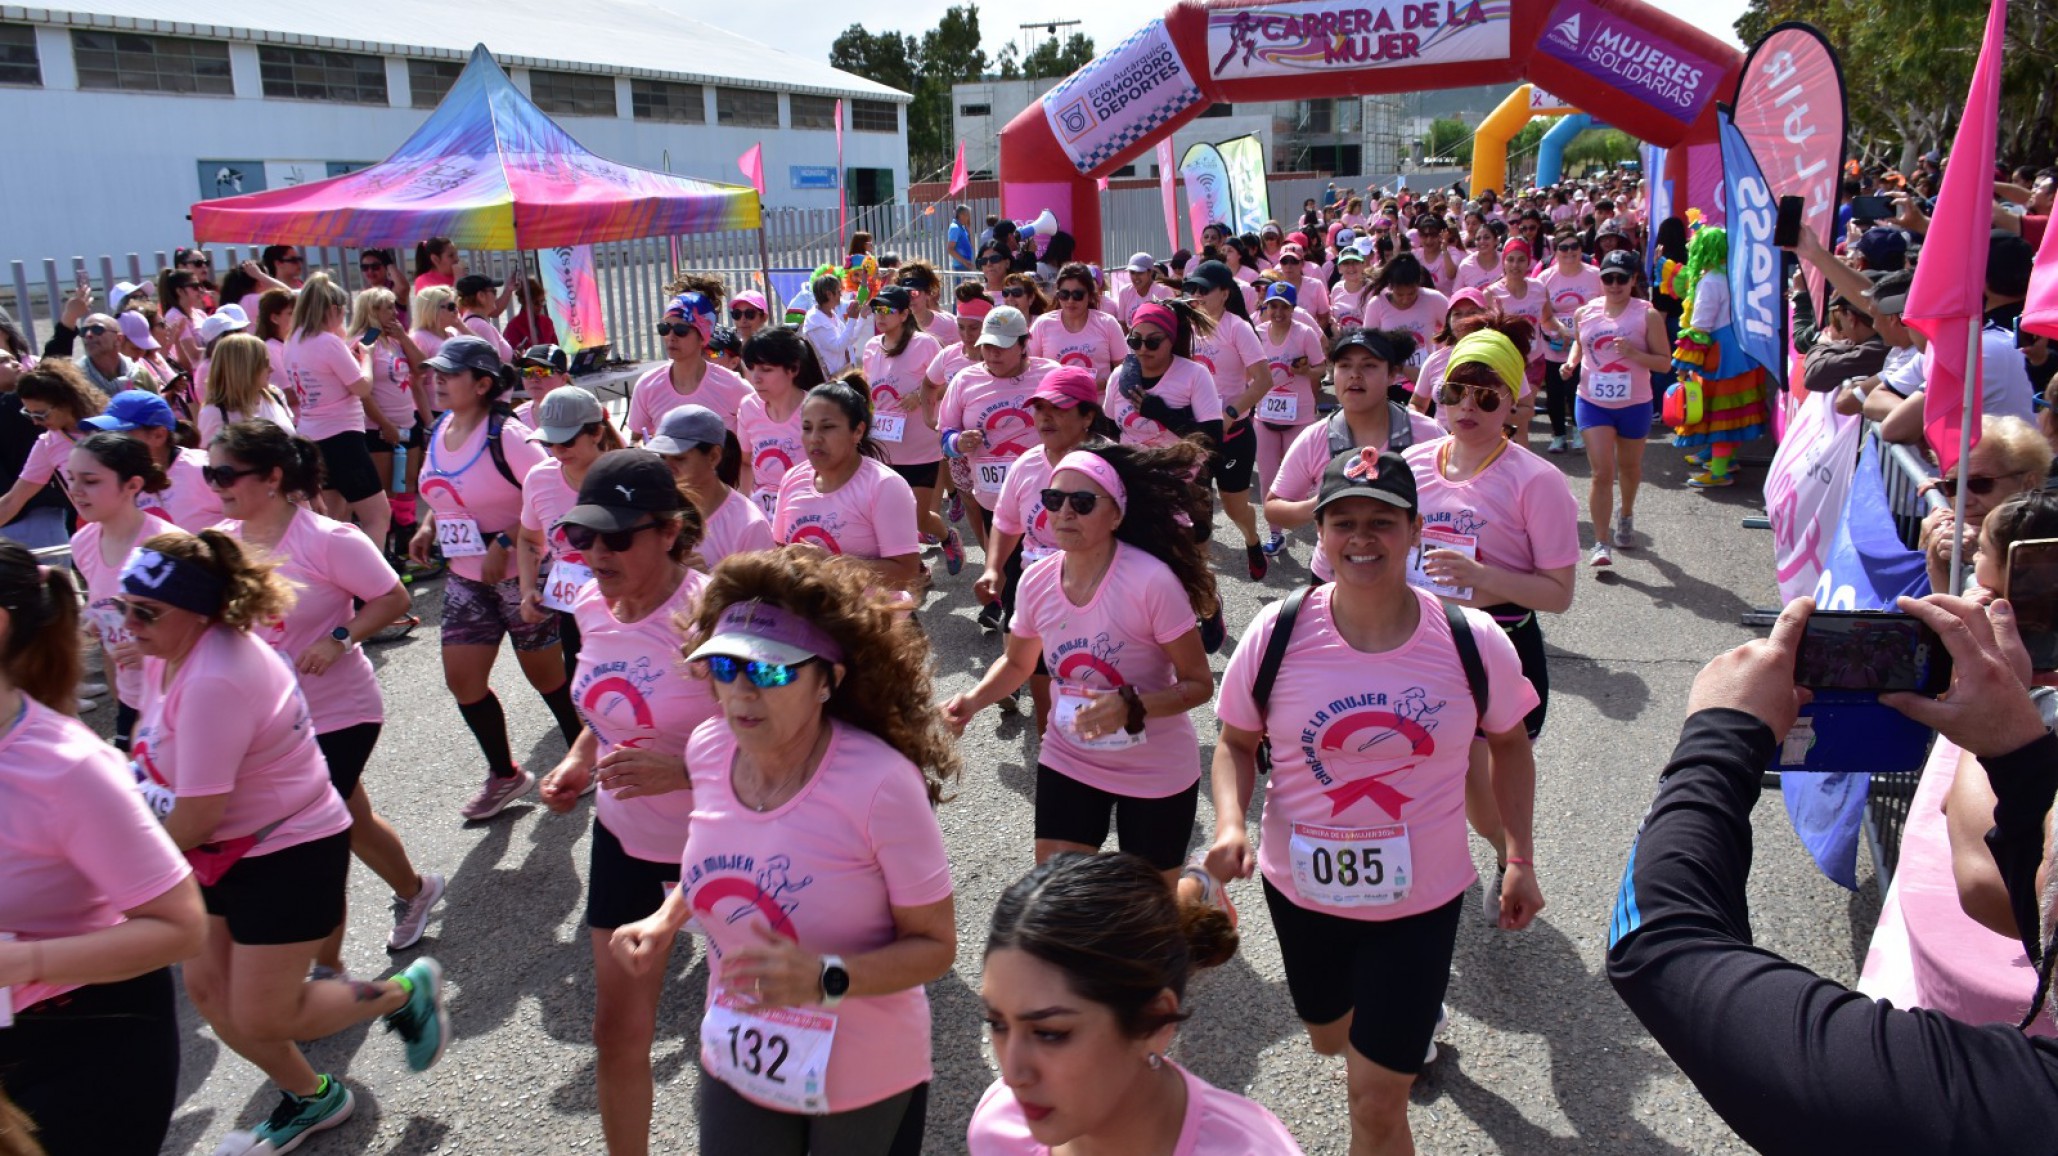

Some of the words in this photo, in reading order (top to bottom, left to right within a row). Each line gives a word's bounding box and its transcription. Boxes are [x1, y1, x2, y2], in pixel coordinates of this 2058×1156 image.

[1262, 7, 1395, 41] CARRERA
[1403, 2, 1439, 29] DE
[1447, 0, 1487, 26] LA
[1324, 32, 1420, 64] MUJER
[1597, 26, 1702, 90] MUJERES
[1088, 79, 1112, 98] Ente
[1113, 42, 1168, 80] Autárquico
[1092, 51, 1172, 108] COMODORO
[1588, 45, 1694, 107] SOLIDARIAS
[1097, 61, 1180, 122] DEPORTES
[1268, 399, 1287, 412] 024
[1595, 384, 1626, 398] 532
[982, 466, 1007, 483] 067
[442, 524, 470, 544] 232
[552, 581, 584, 605] 46
[1058, 638, 1088, 654] MUJER
[592, 661, 627, 677] MUJER
[1301, 728, 1316, 745] DE
[1309, 710, 1330, 728] LA
[1328, 693, 1388, 714] MUJER
[687, 865, 703, 885] LA
[703, 854, 754, 873] MUJER
[1313, 847, 1383, 886] 085
[728, 1024, 789, 1084] 132
